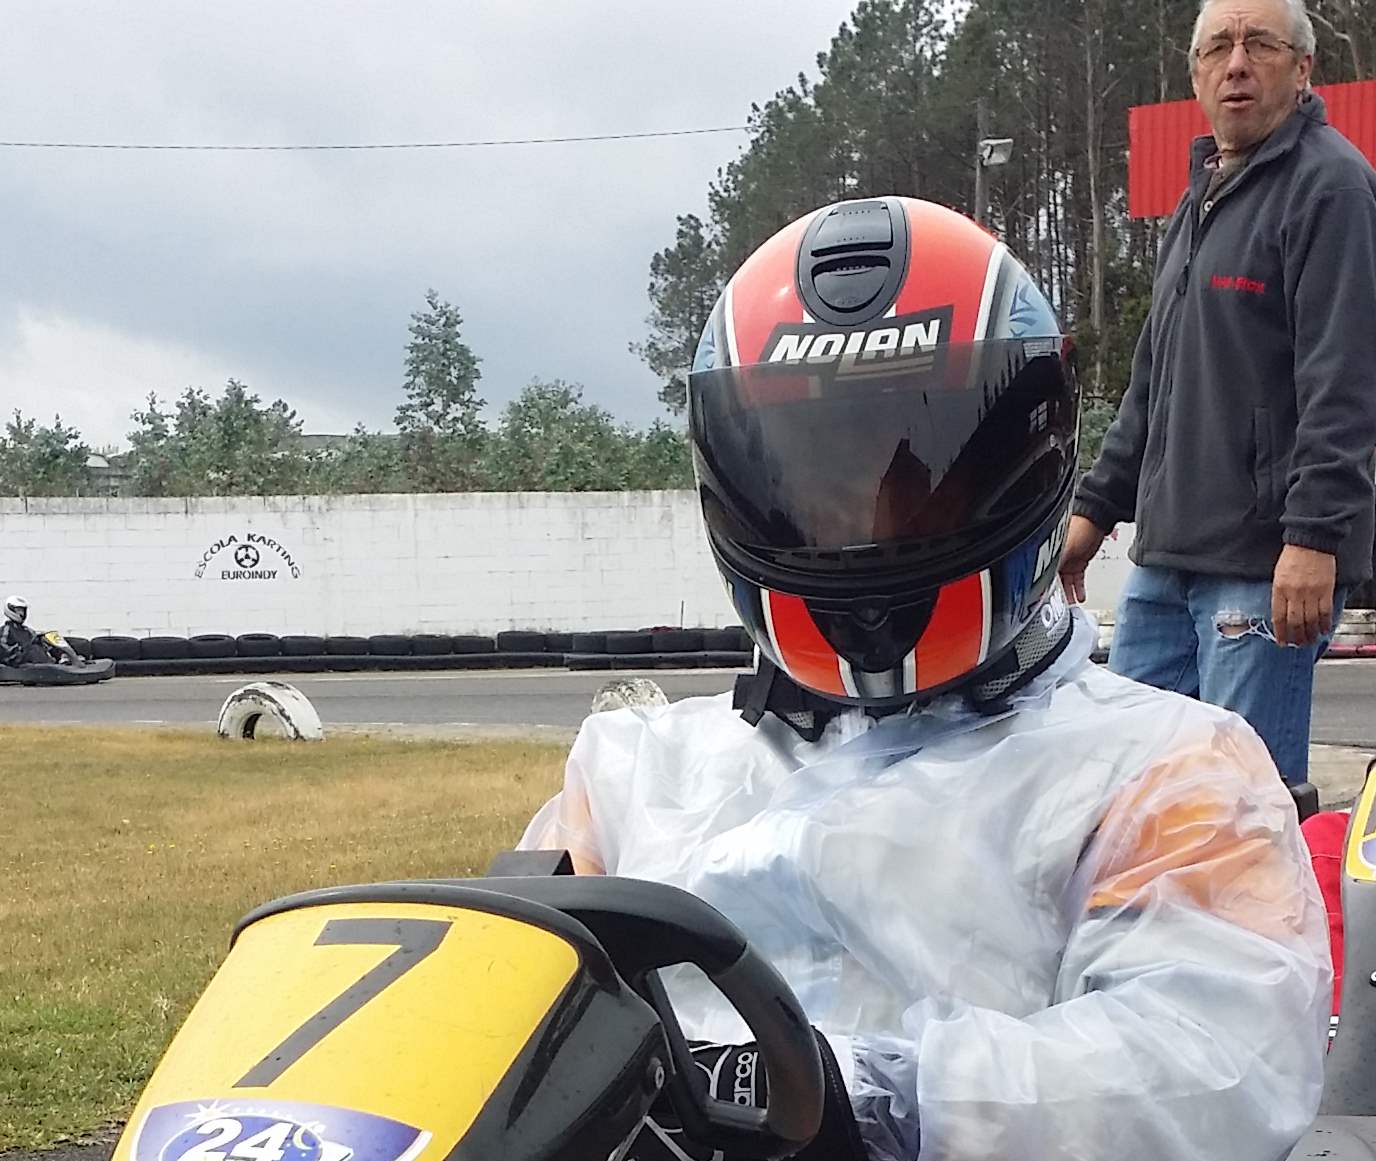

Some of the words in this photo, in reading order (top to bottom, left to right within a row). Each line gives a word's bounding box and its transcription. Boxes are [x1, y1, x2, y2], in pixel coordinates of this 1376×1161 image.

[768, 319, 941, 375] NOLAN
[195, 535, 238, 579] ESCOLA
[247, 533, 301, 579] KARTING
[221, 570, 278, 580] EUROINDY
[232, 919, 453, 1087] 7
[734, 1052, 753, 1106] arco
